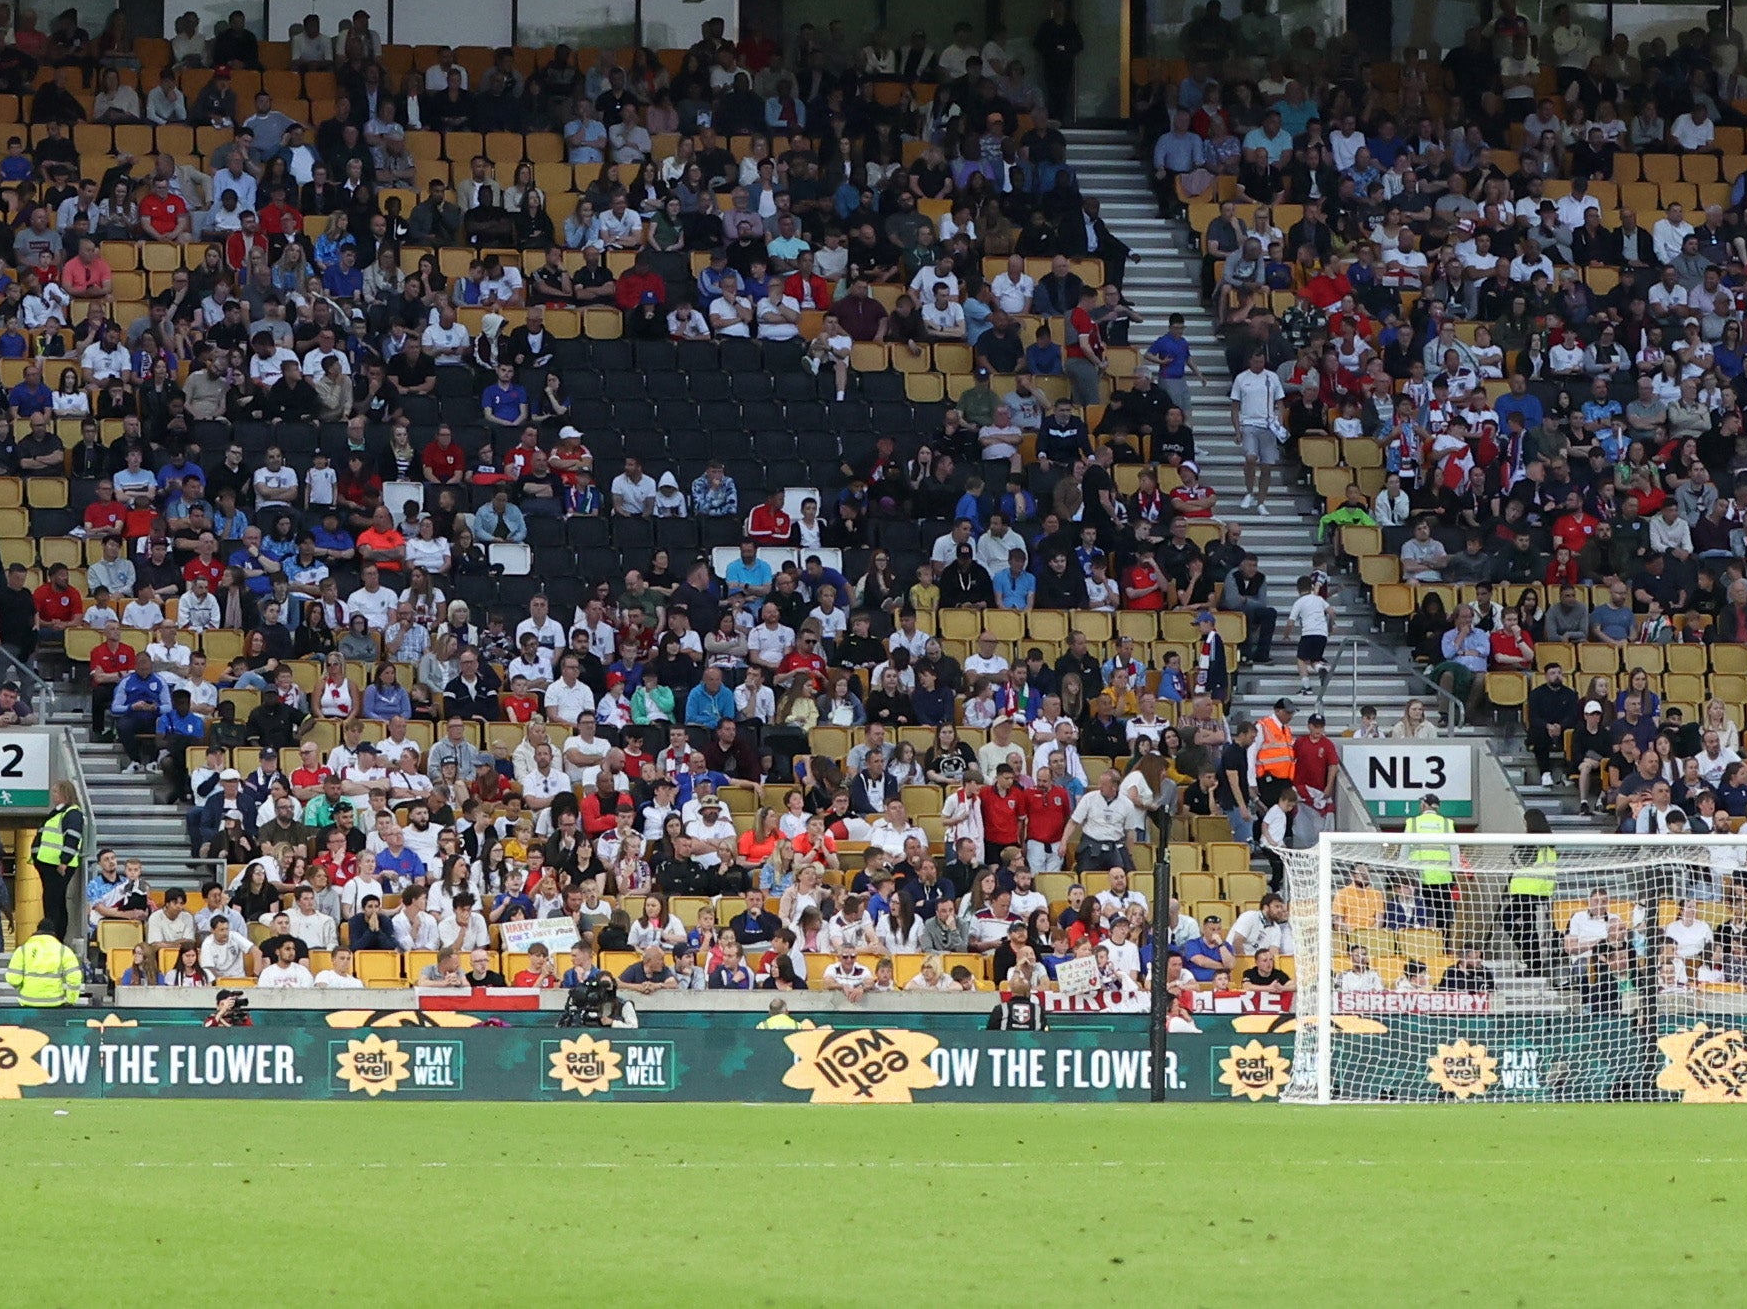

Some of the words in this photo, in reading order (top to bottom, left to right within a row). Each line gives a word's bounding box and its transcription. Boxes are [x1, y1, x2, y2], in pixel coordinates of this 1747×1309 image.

[1368, 755, 1447, 789] NL3
[1341, 993, 1488, 1012] SHREWSBURY
[101, 1044, 160, 1084] THE
[170, 1044, 304, 1085] FLOWER.
[354, 1049, 387, 1064] eat
[415, 1046, 453, 1066] PLAY
[565, 1049, 599, 1063] eat
[627, 1046, 665, 1066] PLAY
[1235, 1054, 1268, 1069] eat
[1503, 1051, 1540, 1070] PLAY
[354, 1060, 393, 1076] well
[414, 1066, 454, 1086] WELL
[566, 1060, 605, 1076] well
[625, 1065, 667, 1086] WELL
[988, 1048, 1047, 1088] THE
[1236, 1065, 1274, 1081] well
[1501, 1070, 1541, 1089] WELL
